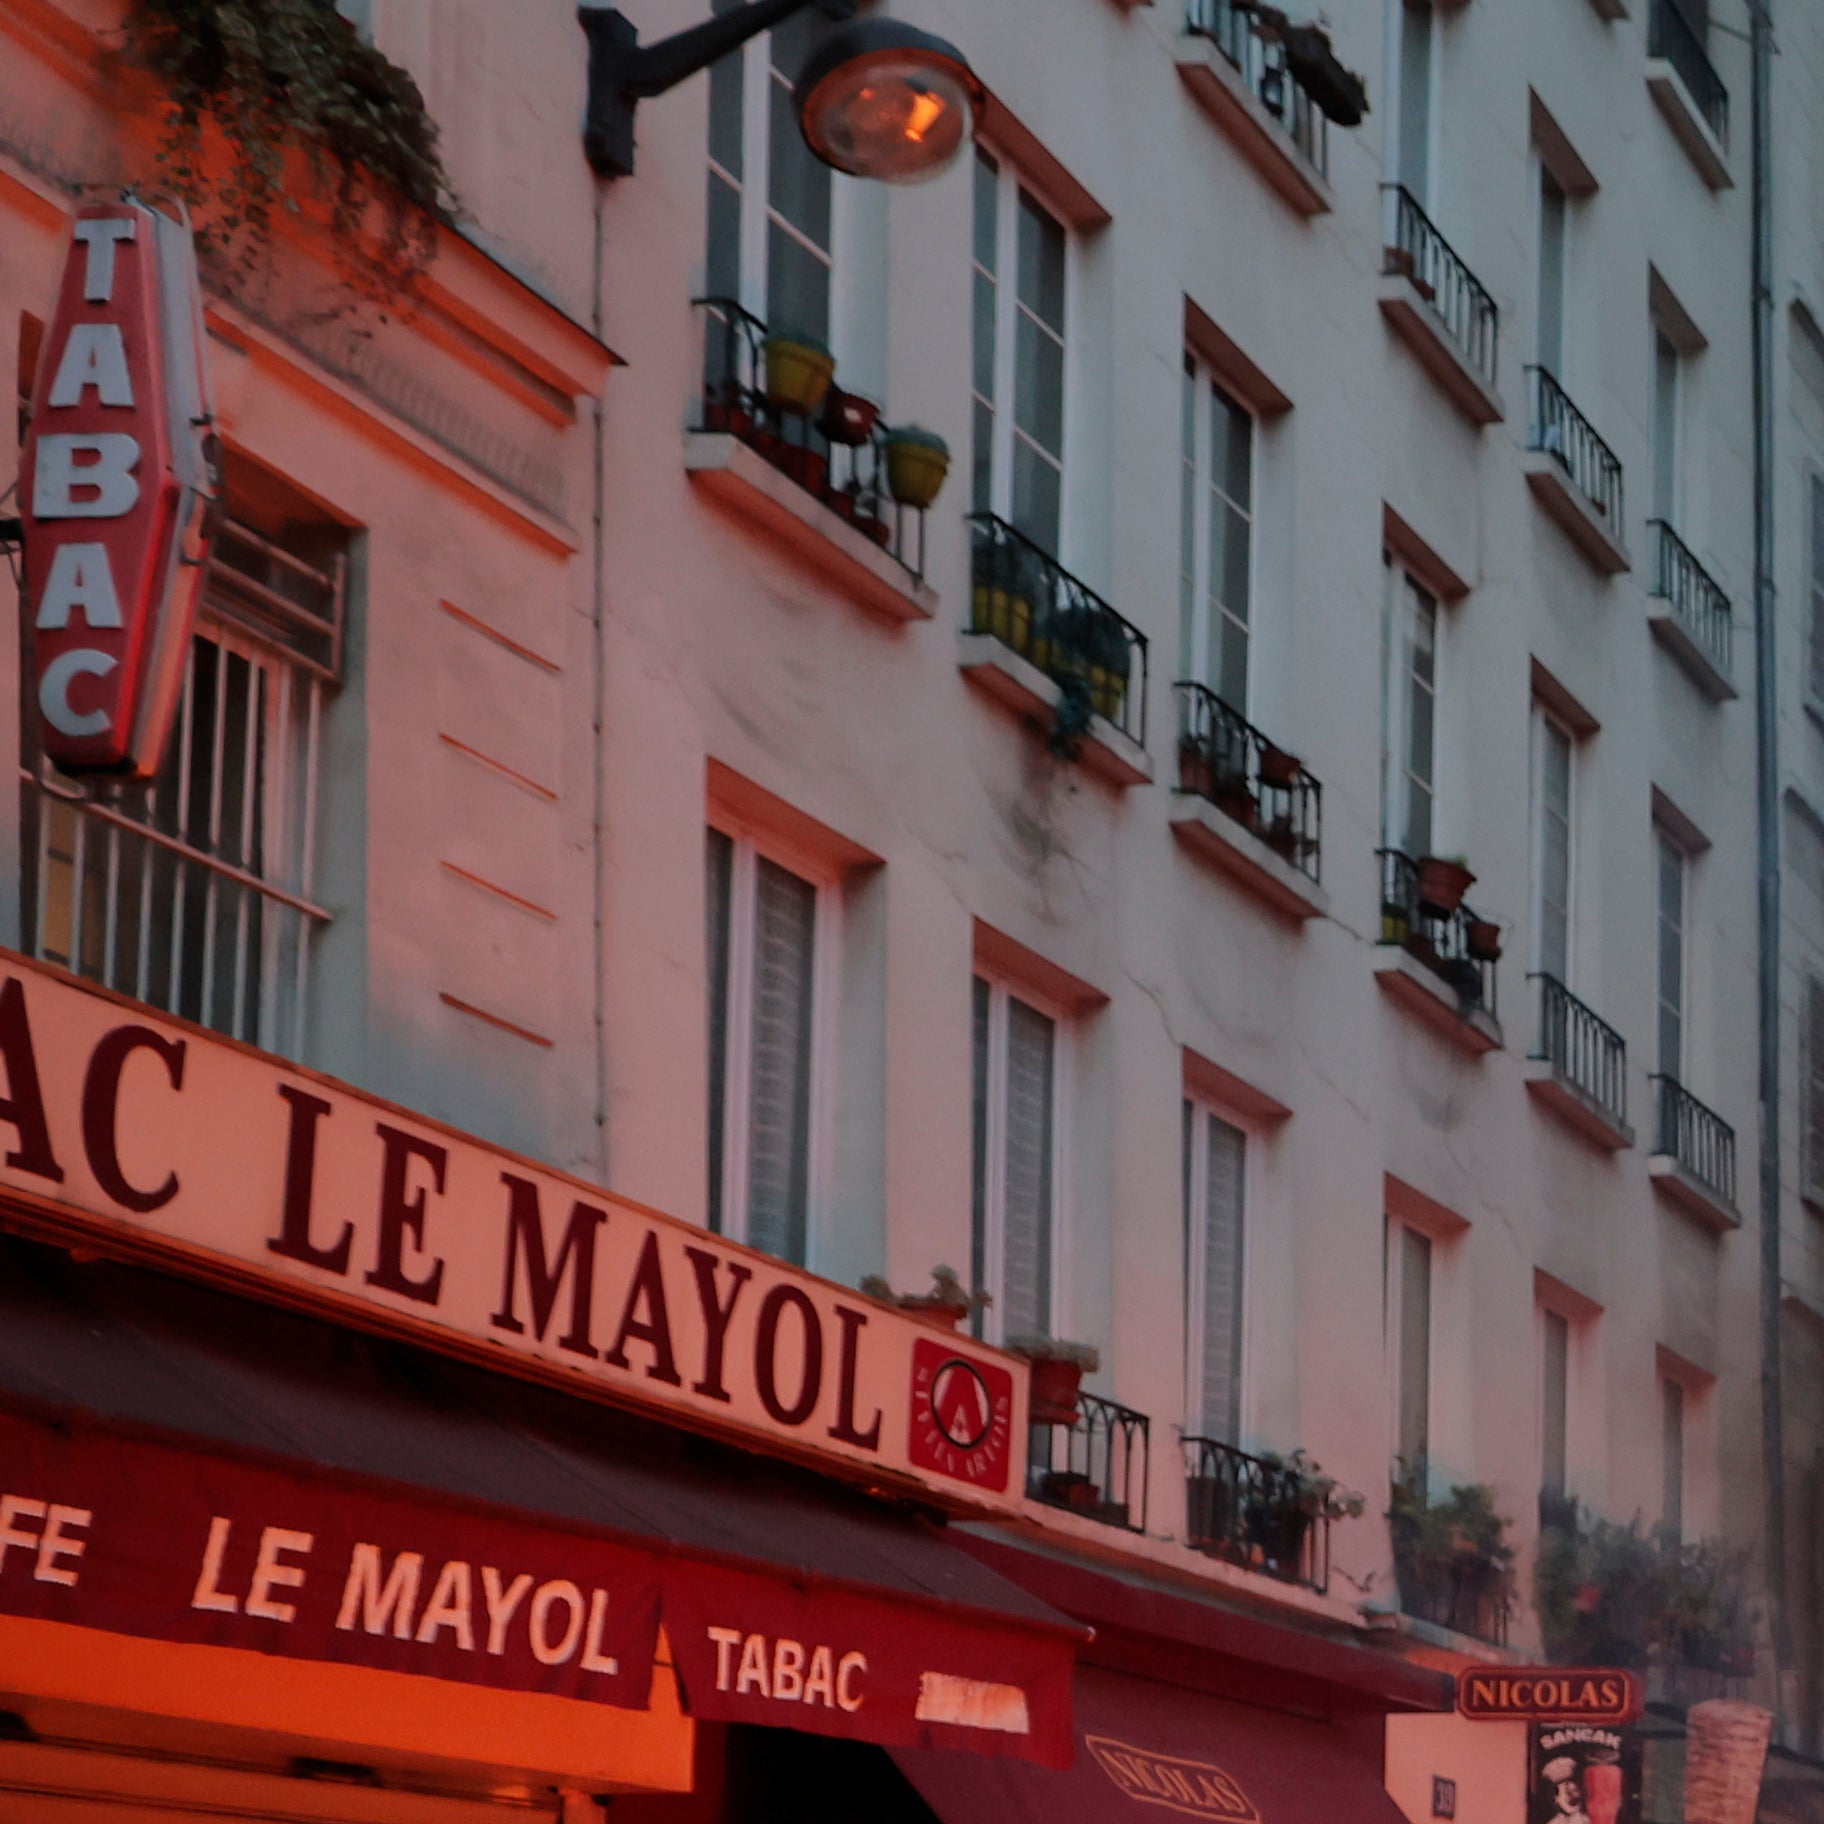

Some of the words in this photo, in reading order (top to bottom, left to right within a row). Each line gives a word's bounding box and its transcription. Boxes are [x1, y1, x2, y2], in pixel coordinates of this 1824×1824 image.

[32, 218, 140, 736] TABAC
[266, 1083, 450, 1305] LE
[491, 1172, 882, 1452] MAYOL
[191, 1516, 315, 1624] LE
[335, 1542, 619, 1676] MAYOL
[707, 1626, 869, 1713] TABAC
[1471, 1678, 1620, 1709] NICOLAS
[1100, 1749, 1247, 1813] NICOLAS
